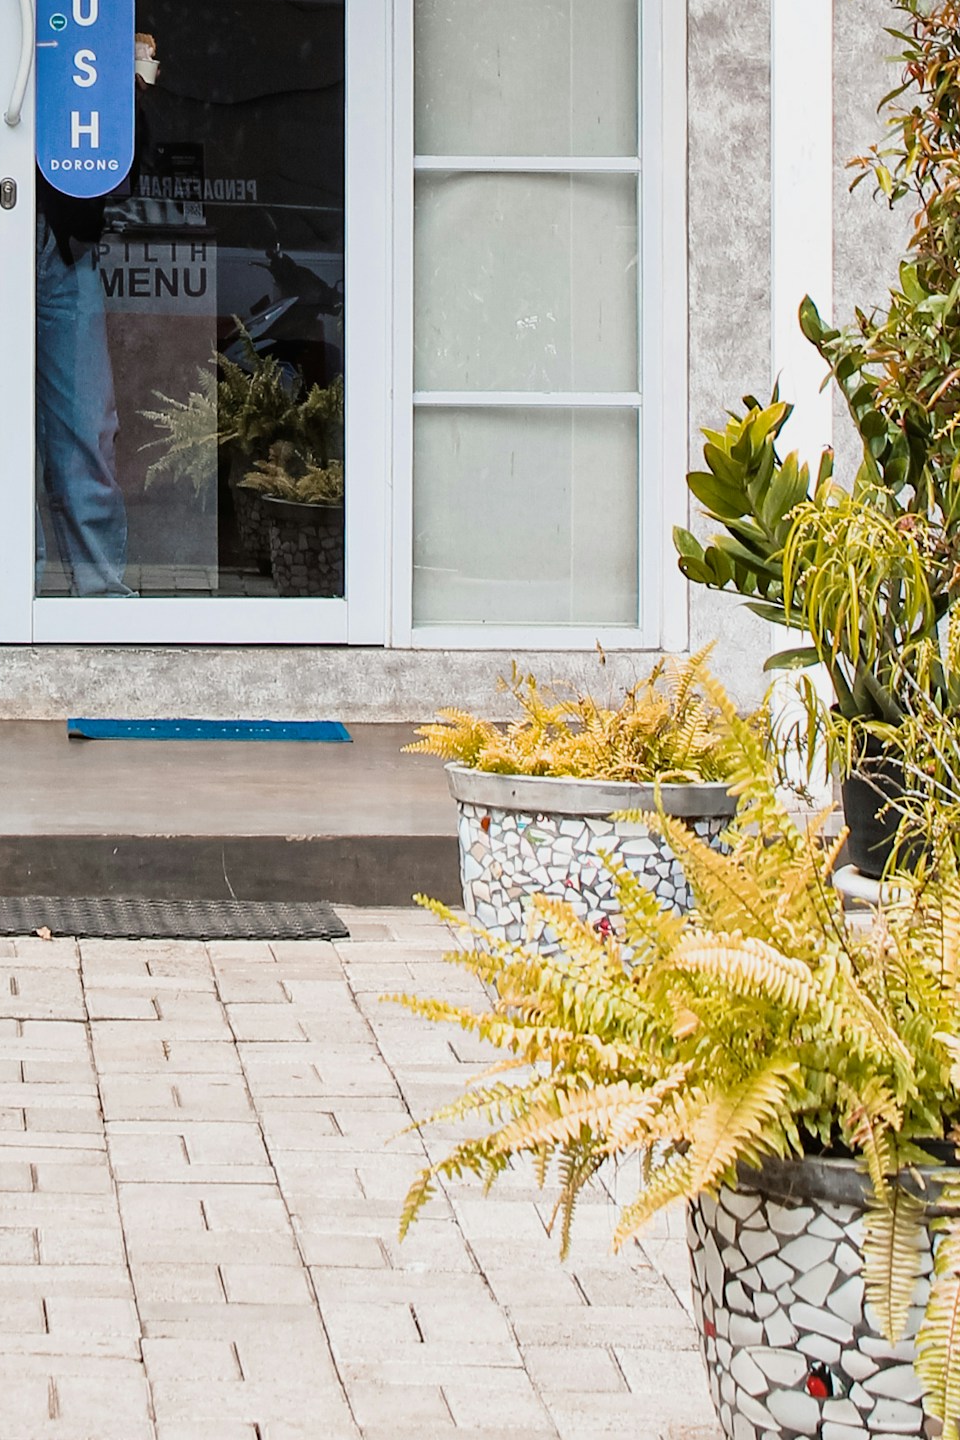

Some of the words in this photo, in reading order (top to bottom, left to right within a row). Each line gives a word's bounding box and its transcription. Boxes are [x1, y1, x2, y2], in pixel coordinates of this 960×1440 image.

[50, 159, 119, 172] DORONG
[95, 242, 207, 263] PILIH
[99, 267, 207, 298] MENU
